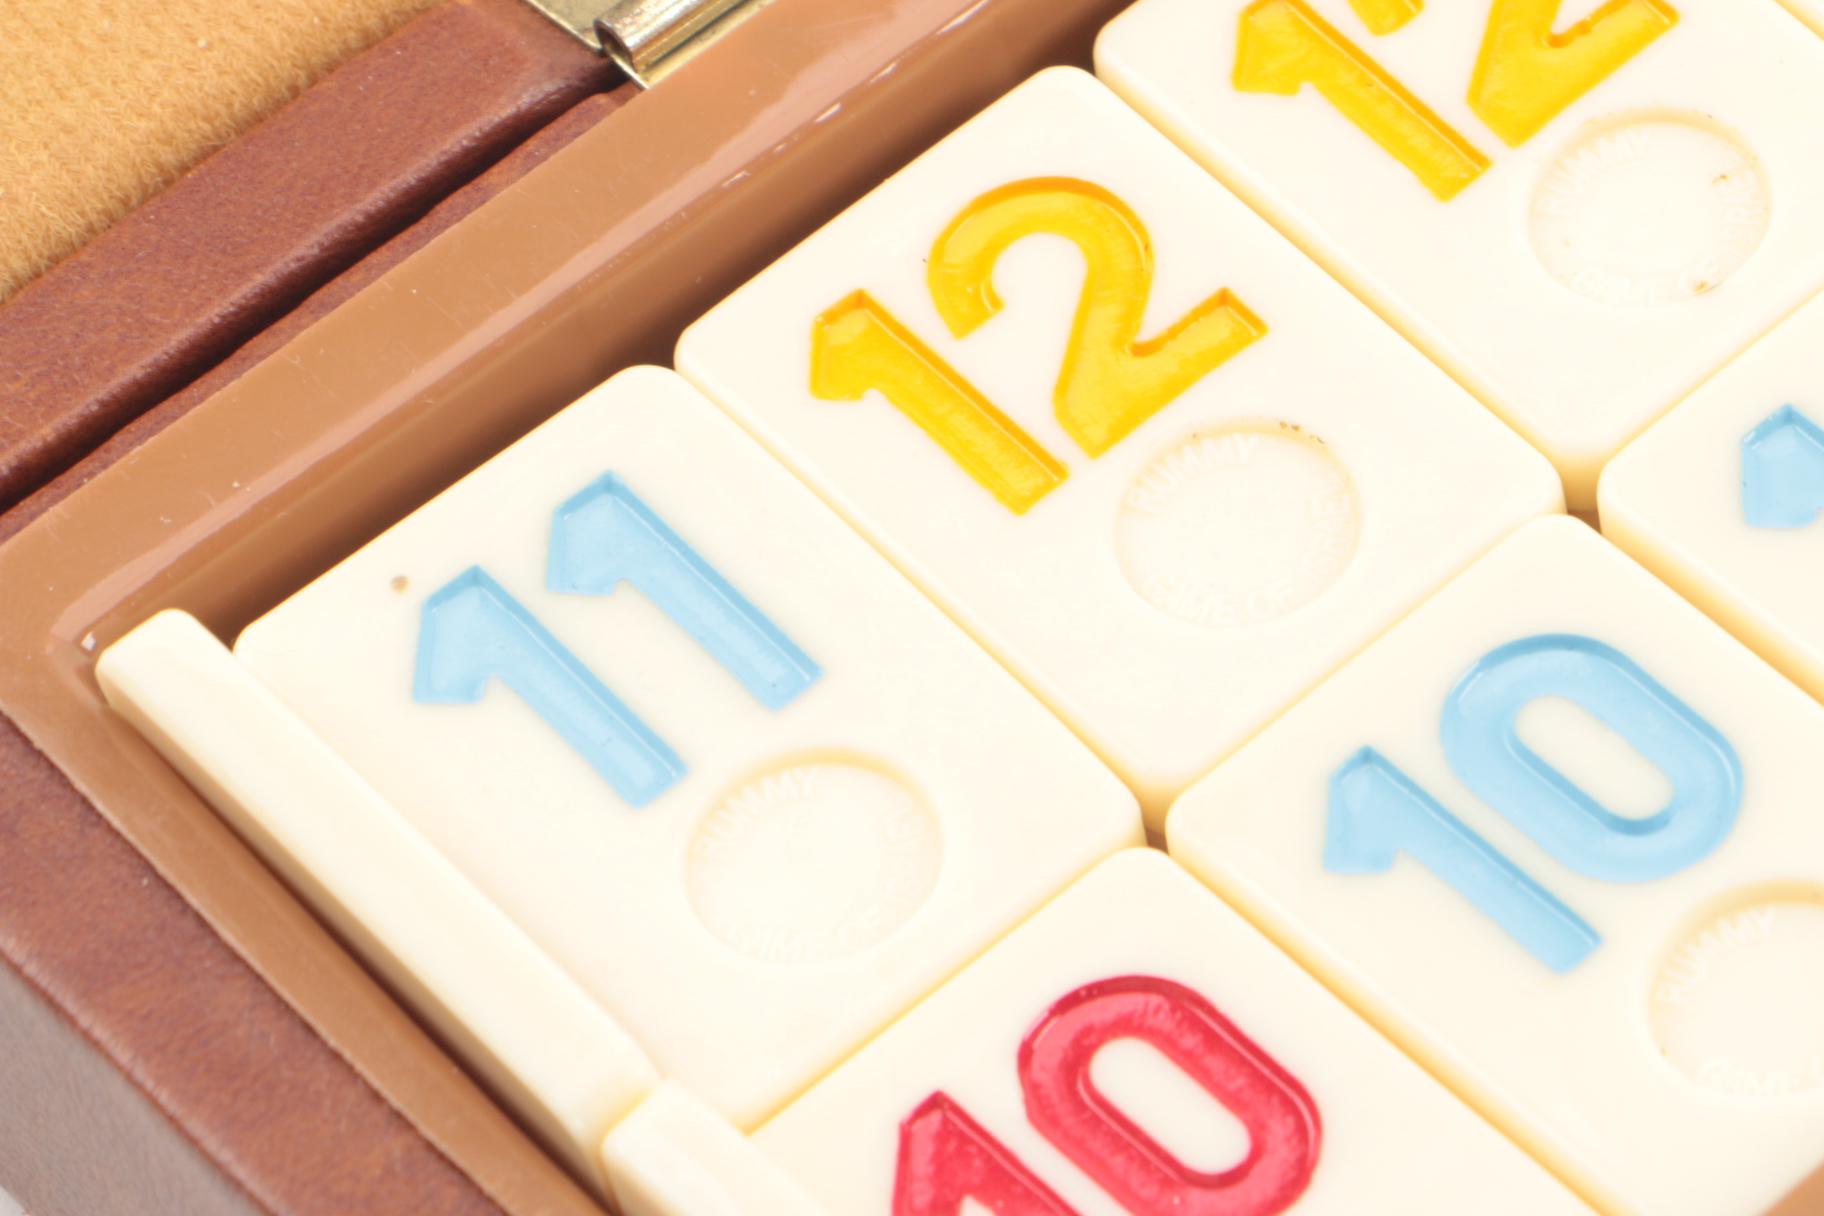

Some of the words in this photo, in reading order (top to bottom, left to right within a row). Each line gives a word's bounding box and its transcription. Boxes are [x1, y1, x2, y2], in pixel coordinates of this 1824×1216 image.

[808, 175, 1270, 517] 12
[411, 470, 825, 809] 11
[1323, 632, 1745, 974] 10
[890, 972, 1325, 1216] 10
